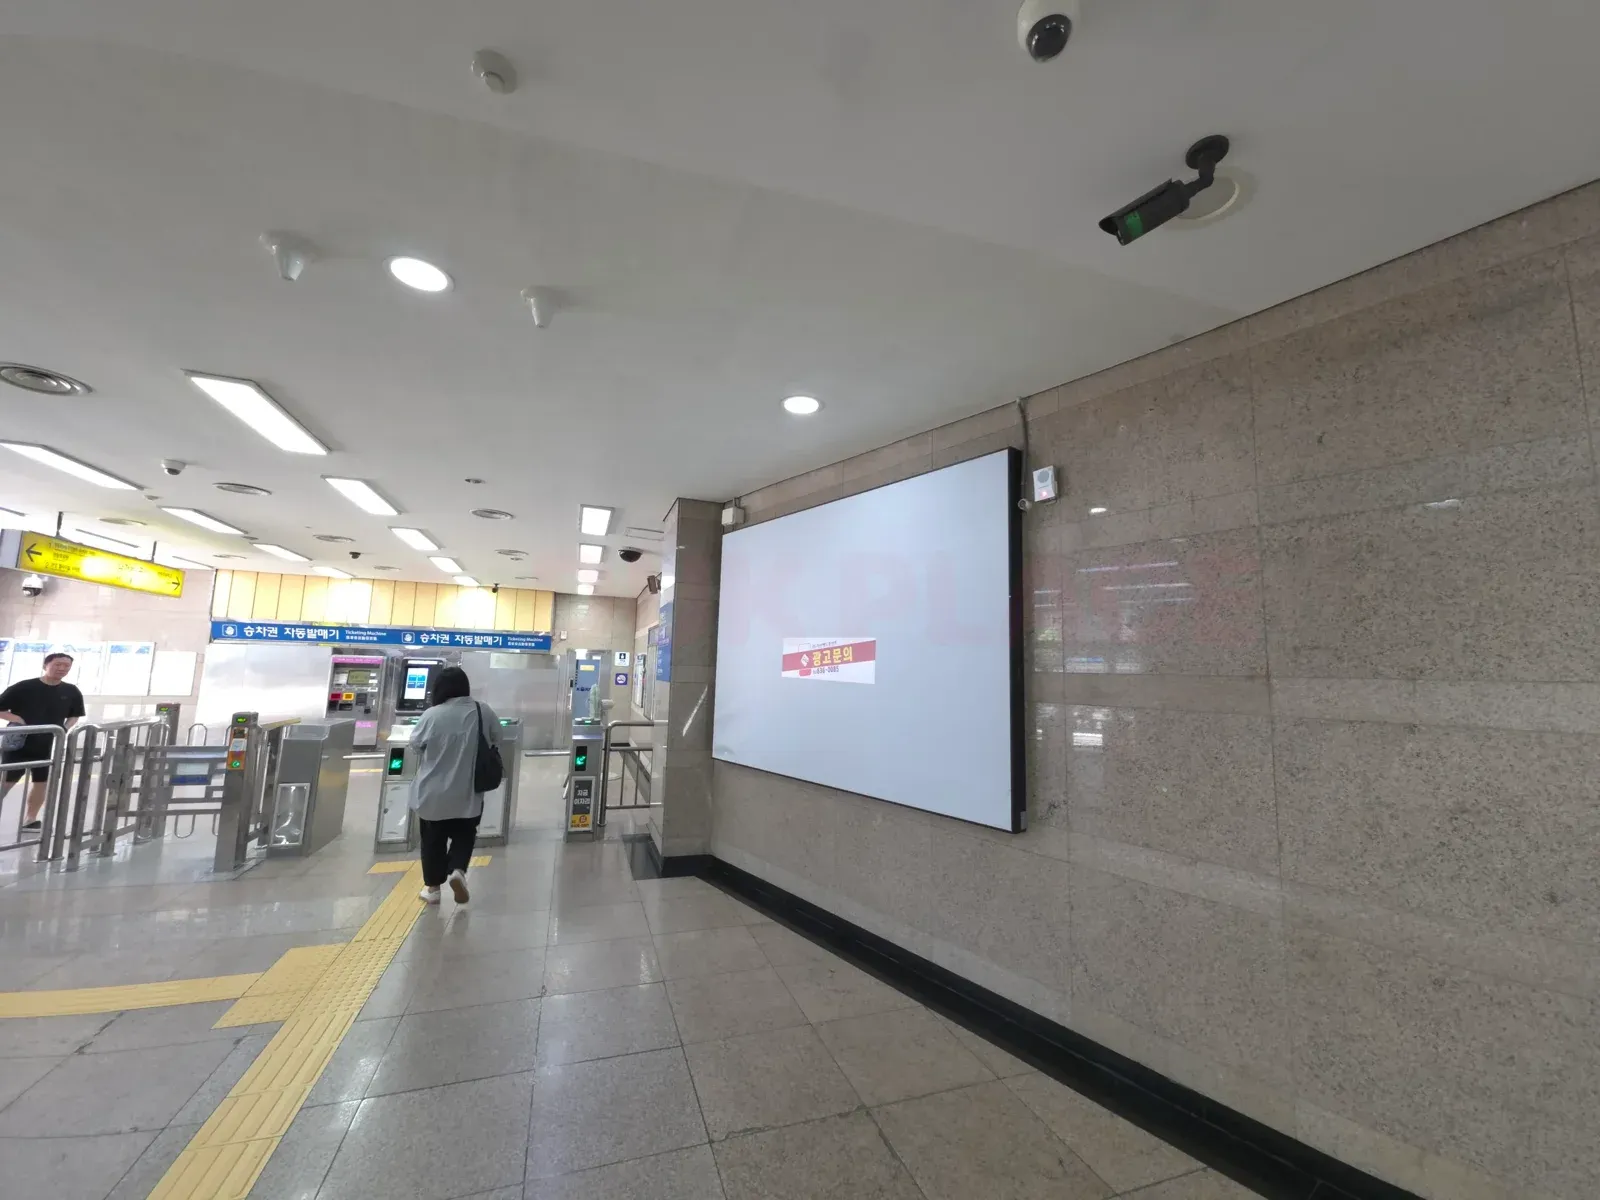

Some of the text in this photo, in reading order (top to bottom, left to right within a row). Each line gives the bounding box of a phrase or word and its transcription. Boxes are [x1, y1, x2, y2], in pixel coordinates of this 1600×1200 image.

[243, 625, 278, 638] 승차권
[284, 627, 339, 640] 자동발매기
[420, 632, 450, 644] 승차권
[454, 634, 502, 646] 자동발매기
[812, 646, 853, 667] 광고문의
